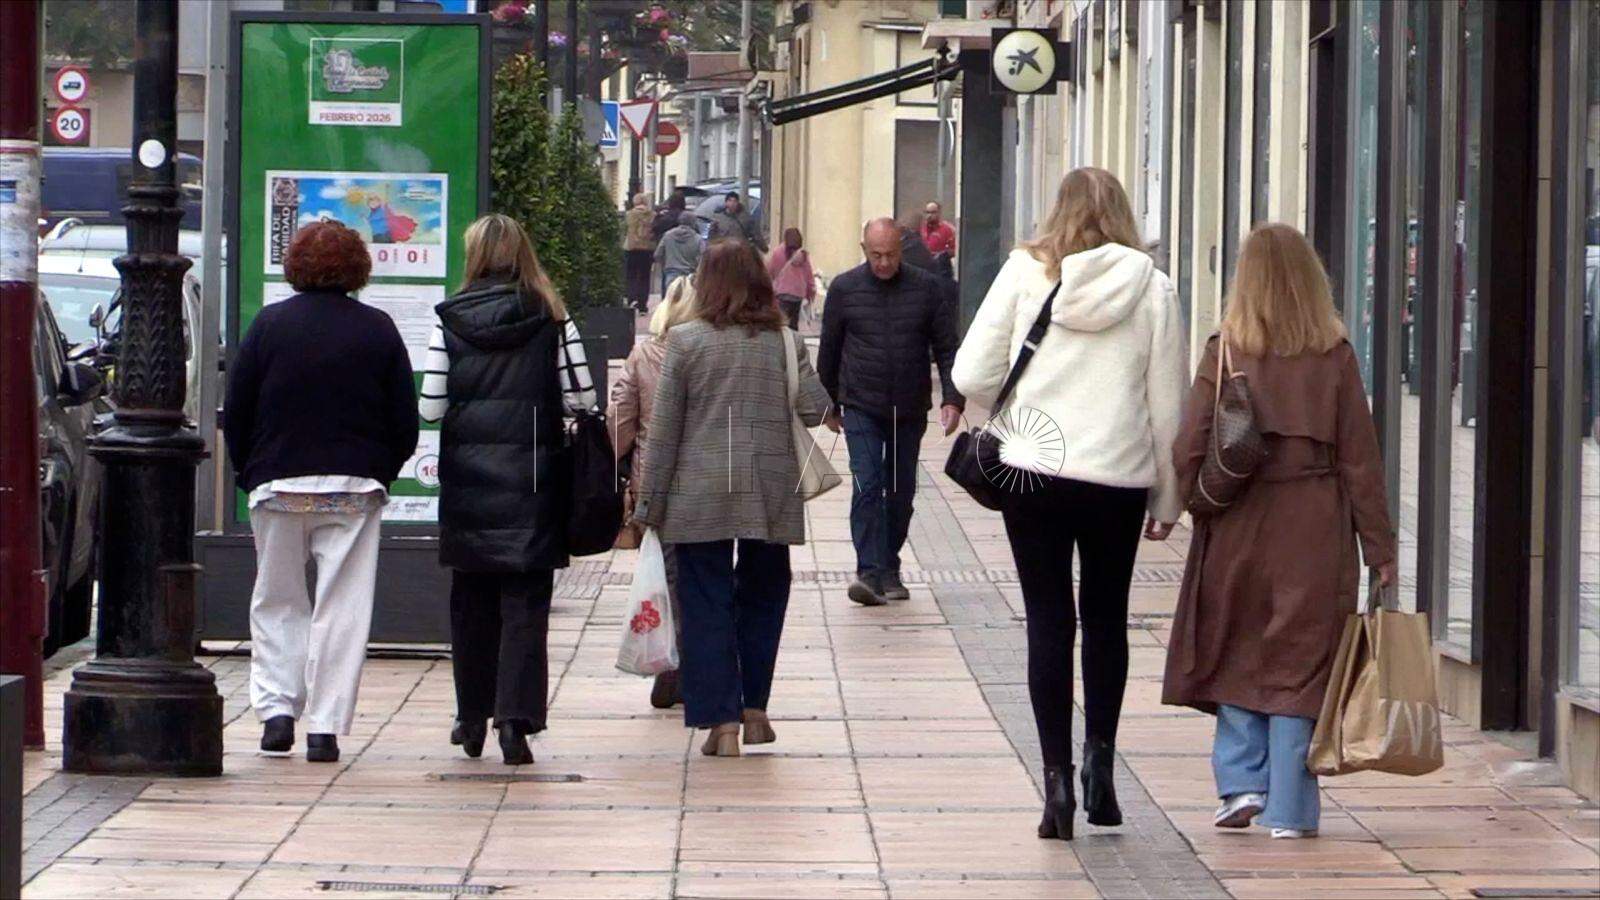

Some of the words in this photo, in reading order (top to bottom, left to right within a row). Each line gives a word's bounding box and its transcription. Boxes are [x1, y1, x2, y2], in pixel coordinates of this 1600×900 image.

[319, 112, 364, 122] FEBRERO
[60, 118, 81, 131] 20
[281, 206, 291, 263] ARIDAD
